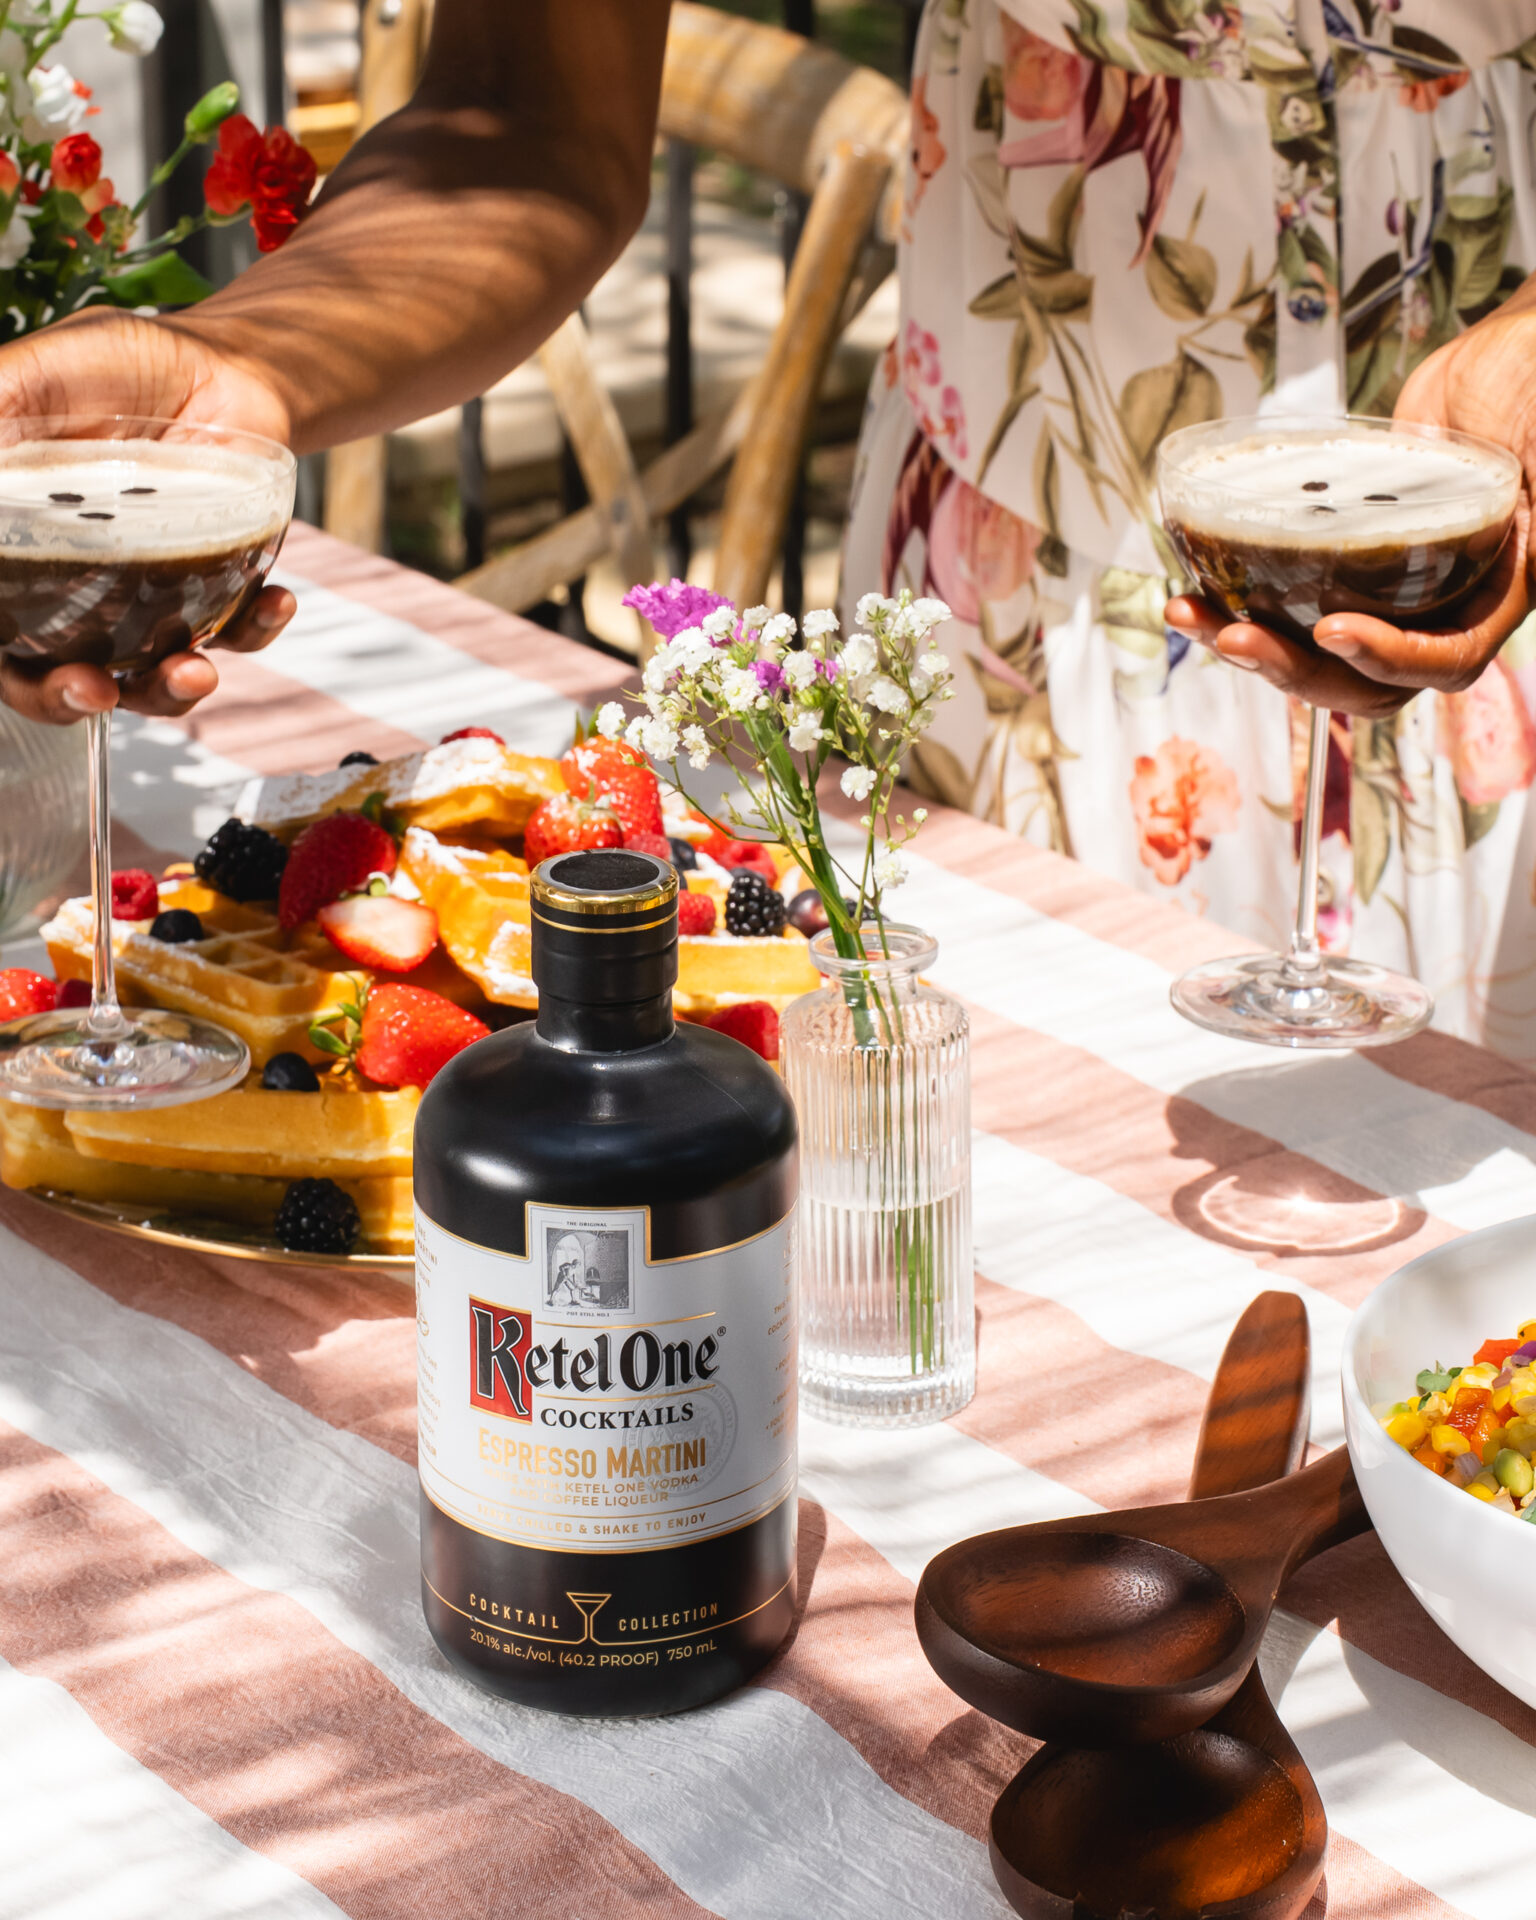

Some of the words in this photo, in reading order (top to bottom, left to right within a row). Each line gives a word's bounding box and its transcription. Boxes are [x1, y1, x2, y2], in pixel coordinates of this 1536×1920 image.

[540, 1402, 694, 1429] COCKTAILS
[478, 1427, 597, 1479] ESPRESSO
[606, 1437, 706, 1479] MARTINI
[510, 1487, 539, 1500] AND
[543, 1492, 599, 1507] COFFEE
[604, 1492, 669, 1507] LIQUEUR
[524, 1477, 560, 1491] WITH
[564, 1482, 610, 1494] KETEL
[614, 1481, 646, 1494] ONE
[650, 1474, 699, 1491] VODKA
[517, 1516, 573, 1533] CHILLED
[578, 1524, 588, 1534] &
[594, 1523, 639, 1535] SHAKE
[645, 1521, 661, 1531] TO
[667, 1512, 706, 1529] ENJOY
[469, 1593, 559, 1629] COCKTAIL
[618, 1602, 718, 1632] COLLECTION
[469, 1628, 500, 1651] 20.1%
[503, 1643, 556, 1663] alc./vol.
[559, 1651, 596, 1667] (40.2
[600, 1650, 659, 1667] PROOF)
[667, 1645, 693, 1661] 750
[696, 1639, 718, 1655] mL
